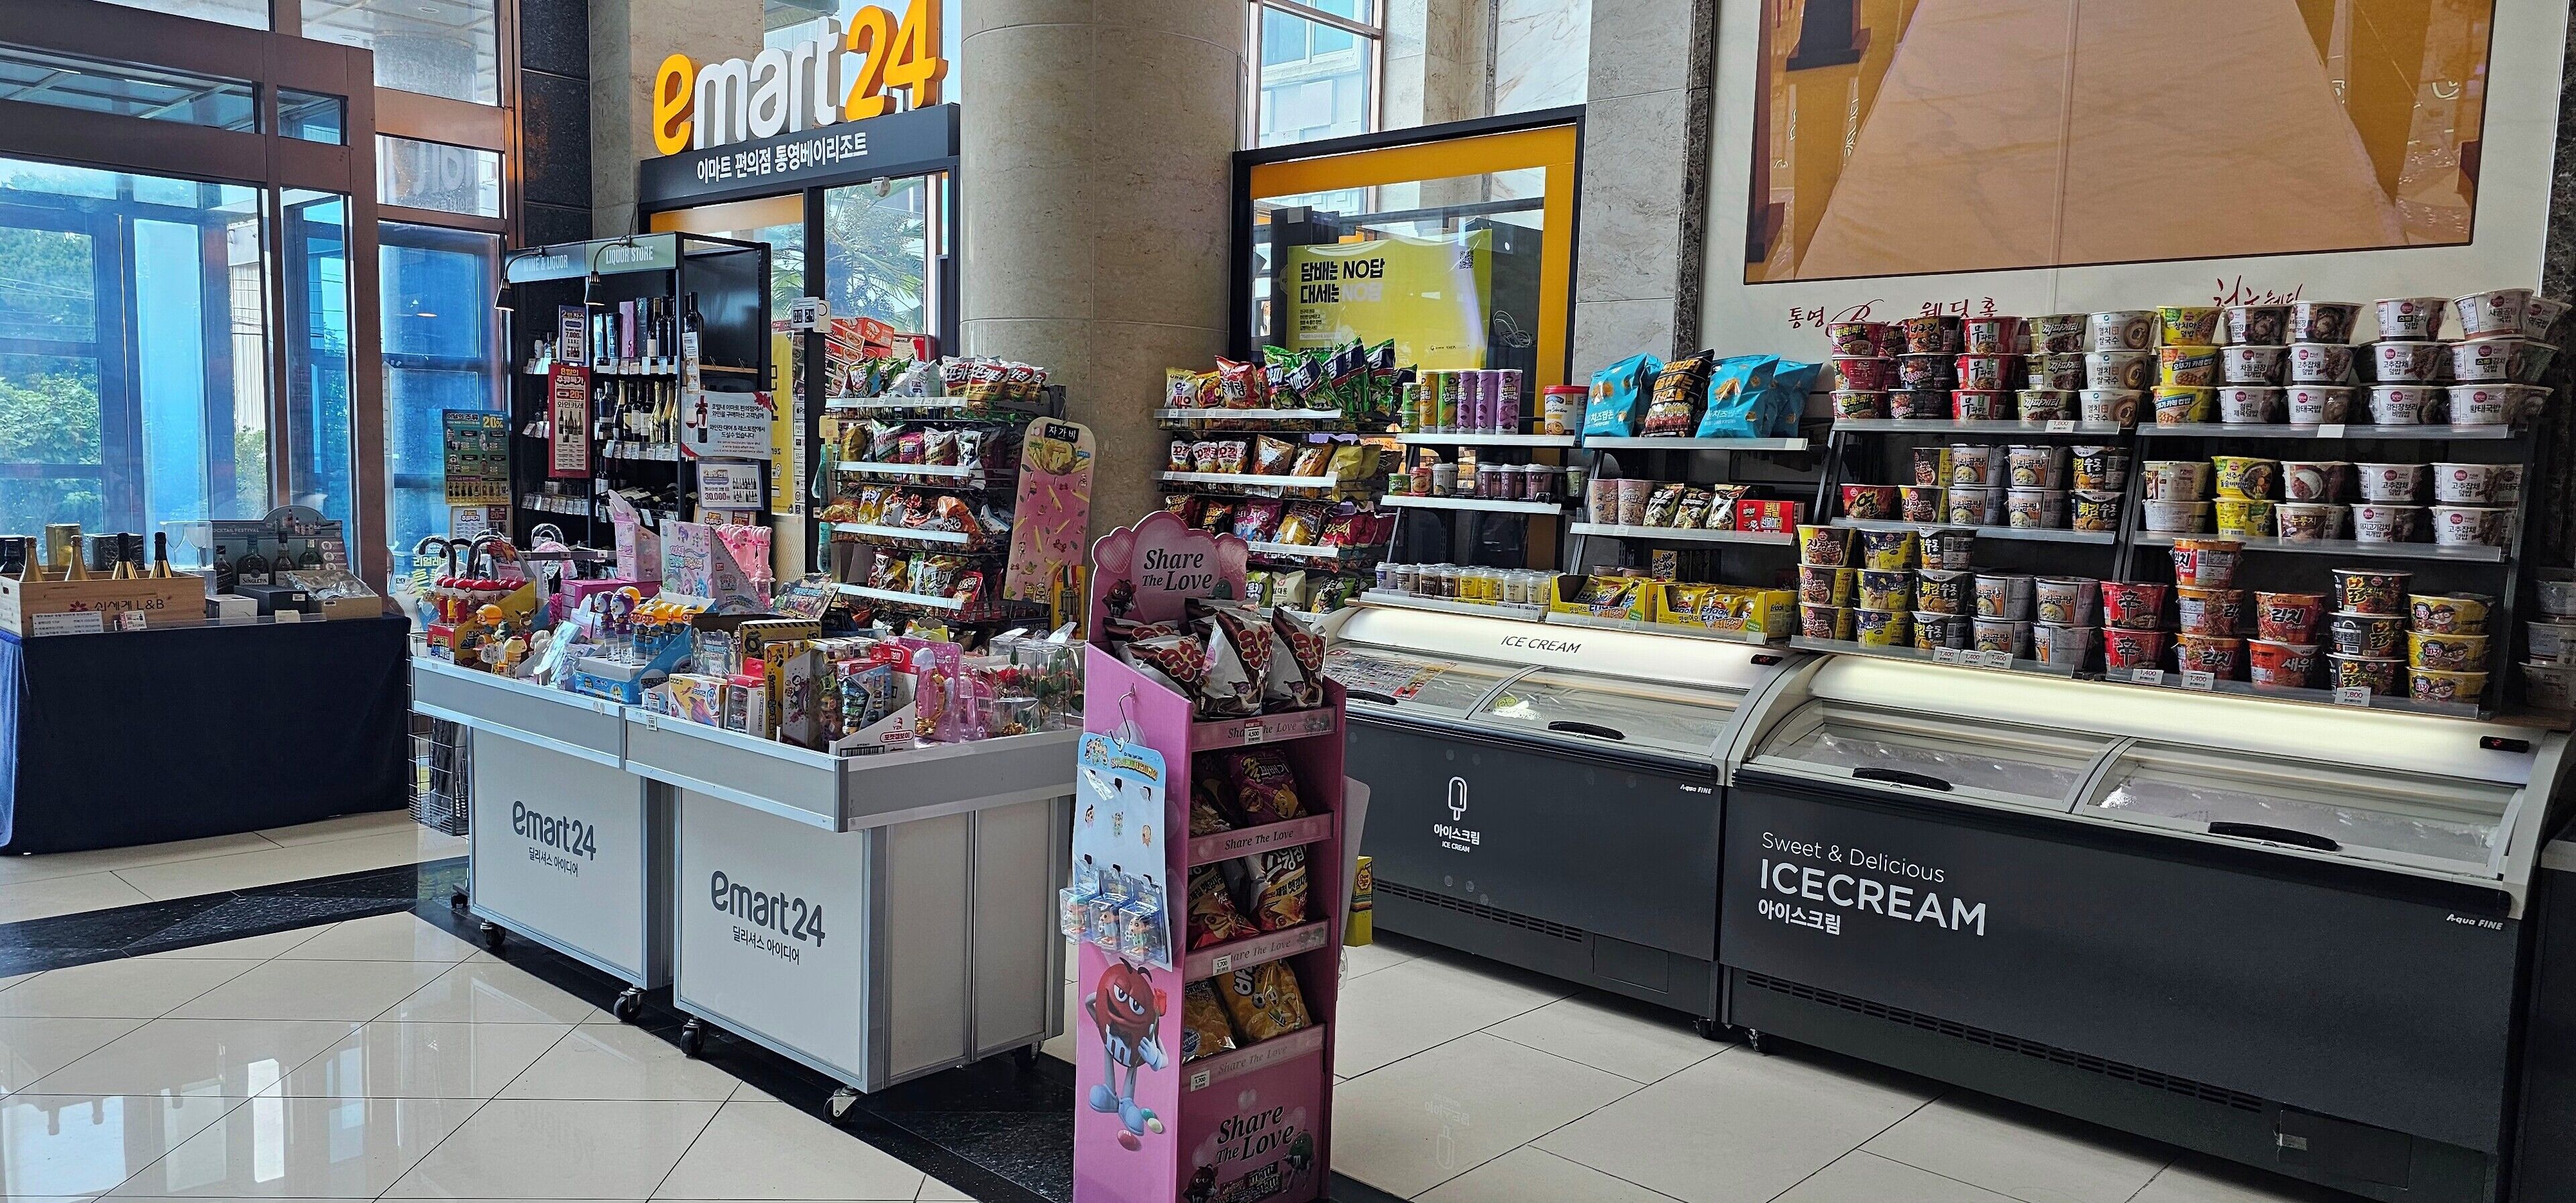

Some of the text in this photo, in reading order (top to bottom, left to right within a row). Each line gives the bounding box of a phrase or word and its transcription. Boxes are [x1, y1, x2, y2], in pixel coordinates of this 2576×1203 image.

[697, 132, 868, 184] 이마트 편의점 통영베이리조트
[523, 254, 568, 272] WINE & LIQUOR
[606, 246, 653, 266] LIQUOR STORE
[1301, 258, 1385, 282] 담배는 NO답
[1300, 284, 1340, 304] 대세는
[1788, 306, 1825, 329] 통영
[1910, 321, 1937, 334] 너구리
[2042, 322, 2078, 335] 짜파게티
[2098, 327, 2110, 336] 멸치
[2404, 322, 2418, 330] 덮밥
[2098, 336, 2120, 346] 쌀국수
[2096, 366, 2110, 376] 멸치
[2297, 361, 2321, 369] 고추잡채
[2383, 361, 2409, 369] 고추잡채
[2483, 365, 2498, 373] 덮밥
[973, 363, 1005, 383] 포카칩
[2096, 376, 2119, 385] 쌀국수
[2024, 398, 2059, 407] 짜파게티
[2087, 405, 2100, 413] 멸치
[2295, 405, 2321, 414] 황태국밥
[2469, 404, 2502, 414] 황태국밥
[482, 416, 503, 428] 20%
[2087, 413, 2108, 422] 쌀국수
[1049, 425, 1076, 440] 자가비
[2381, 482, 2409, 490] 고추잡채
[2452, 482, 2481, 490] 고추잡채
[2458, 489, 2472, 497] 덮밥
[1902, 499, 1932, 512] 진짬뽕
[2290, 515, 2316, 526] 누룽지
[2449, 525, 2477, 533] 고추잡채
[2455, 533, 2469, 541] 덮밥
[1807, 538, 1840, 552] 진짬뽕
[1144, 548, 1204, 570] Share
[1142, 570, 1213, 592] The Love
[1921, 581, 1957, 596] 튀김우동
[95, 599, 164, 612] 신세계 L&B
[1701, 605, 1730, 616] Enaak
[2271, 607, 2305, 625] 김치
[1501, 635, 1582, 654] ICE CREAM
[2201, 650, 2234, 667] 김치
[1228, 723, 1297, 739] Sha Love
[1680, 783, 1713, 795] Aqua FINE
[513, 800, 596, 861] emart24
[1434, 823, 1481, 845] 아이스크림
[1225, 829, 1294, 851] Share The Love
[1441, 840, 1470, 853] ICE CREAM
[529, 845, 578, 878] 딜리셔스 아이디어
[1762, 831, 1945, 884] Sweet & Delicious
[1760, 858, 1986, 937] ICECREAM
[710, 870, 826, 947] emart24
[1758, 898, 1841, 936] 아이스크림
[2446, 913, 2504, 931] Aqua FINE
[733, 925, 800, 965] 딜리셔스 아이디어
[1251, 940, 1291, 957] The Love
[1218, 1045, 1288, 1074] Share The Love
[1217, 1106, 1285, 1145] Share
[1216, 1124, 1295, 1165] The Love
